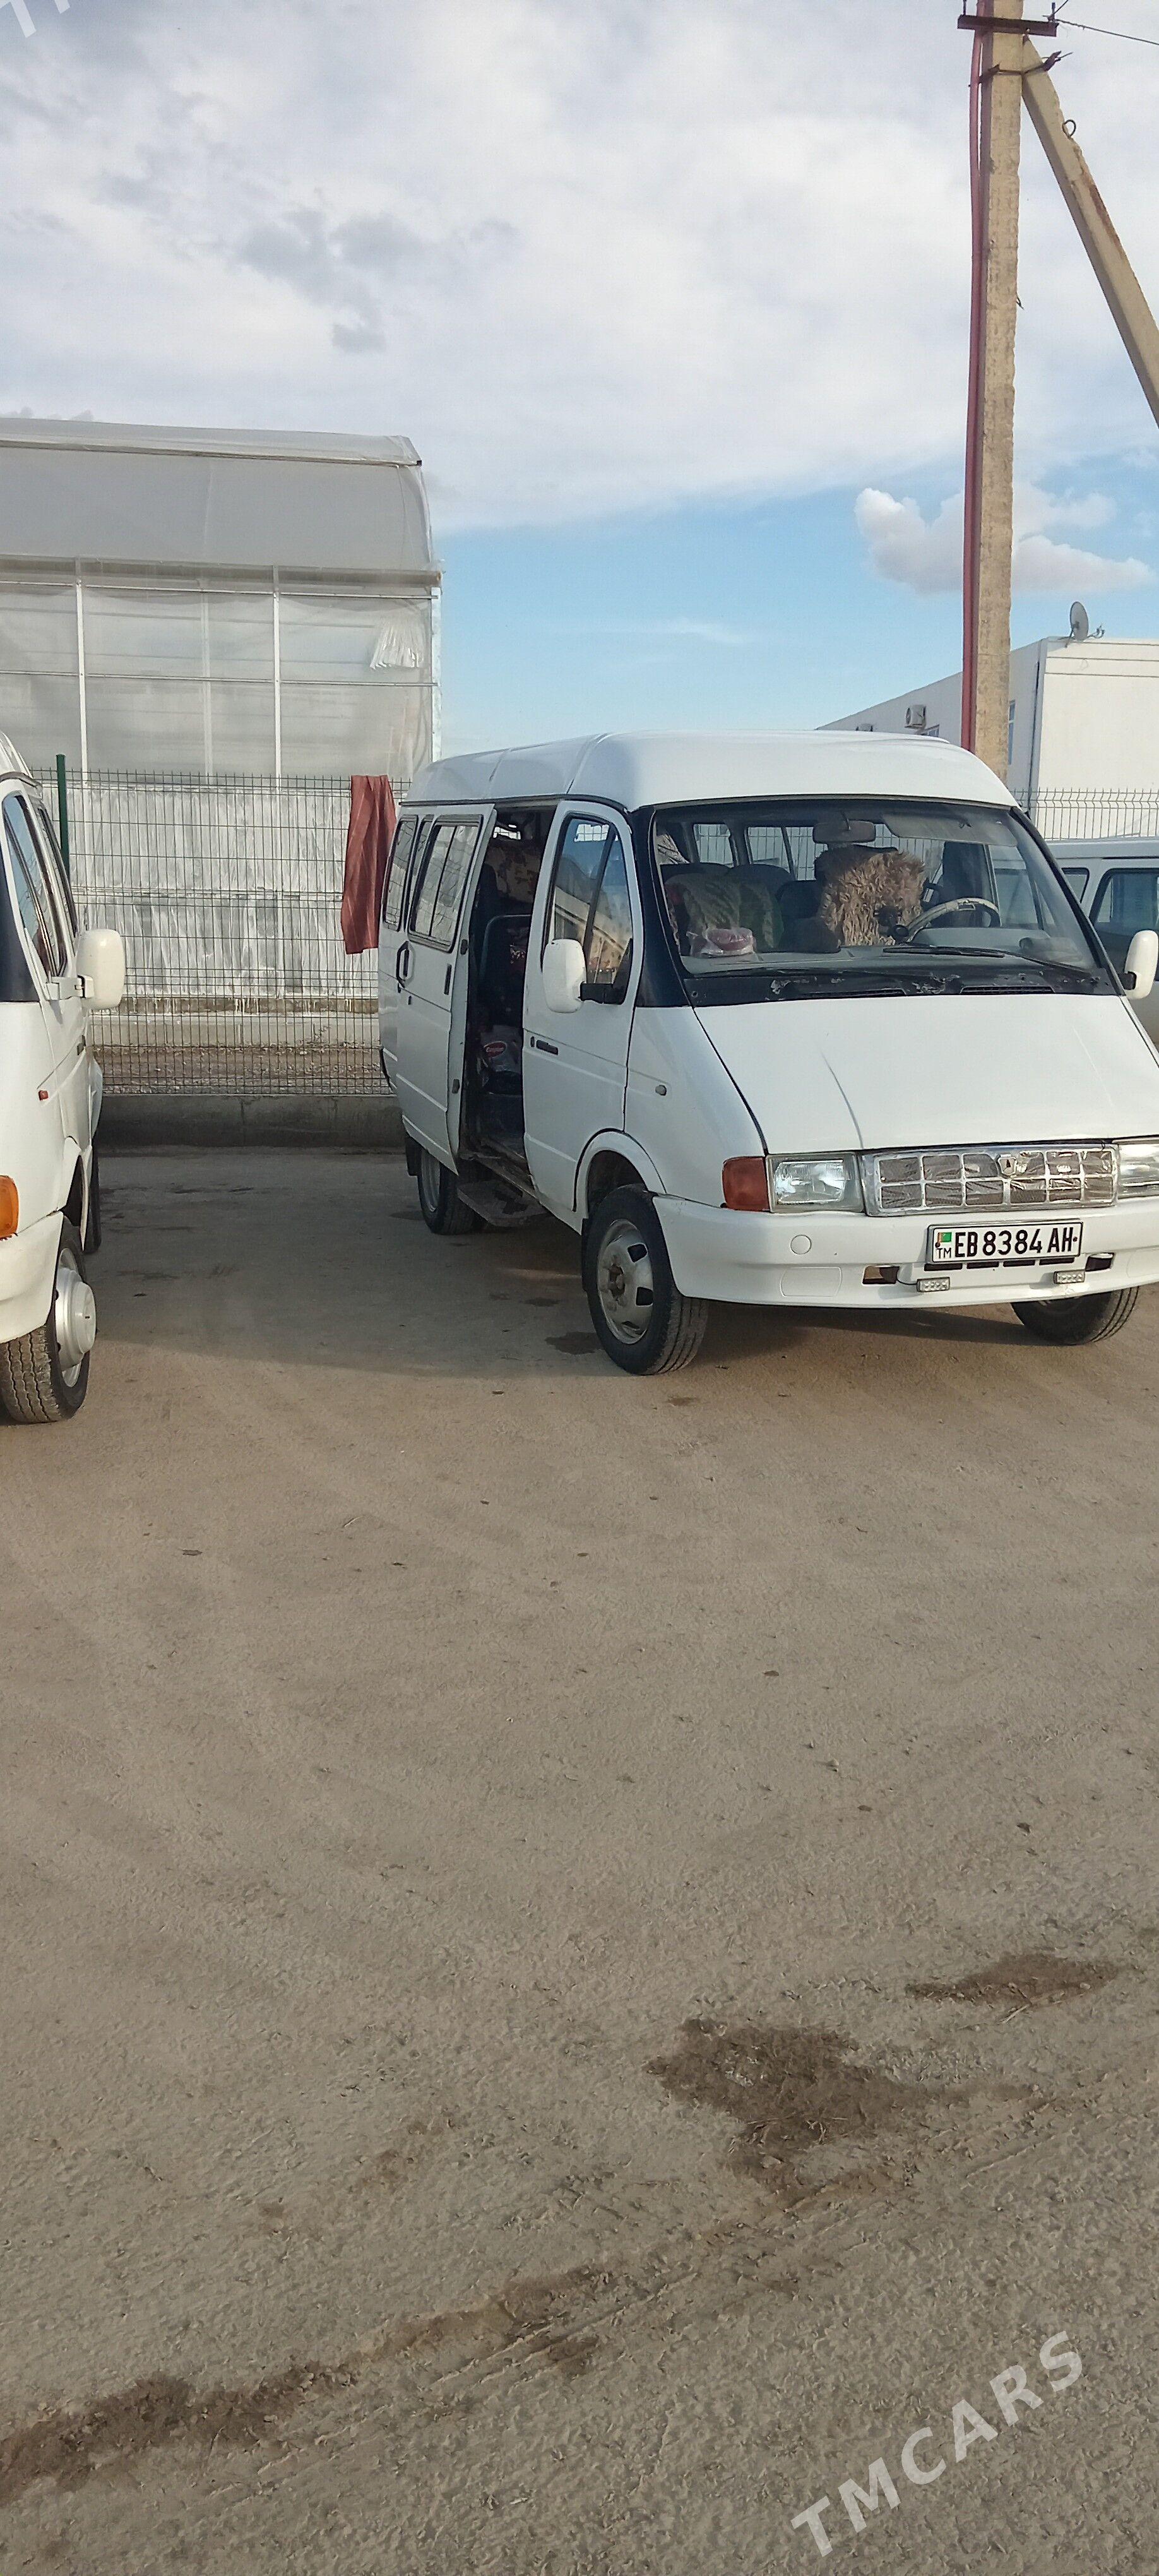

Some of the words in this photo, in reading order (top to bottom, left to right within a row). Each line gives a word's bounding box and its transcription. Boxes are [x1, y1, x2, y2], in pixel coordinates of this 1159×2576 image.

[954, 1232, 978, 1257] EB
[982, 1229, 1042, 1256] 8384
[1047, 1227, 1074, 1253] AH
[937, 1247, 952, 1259] TM
